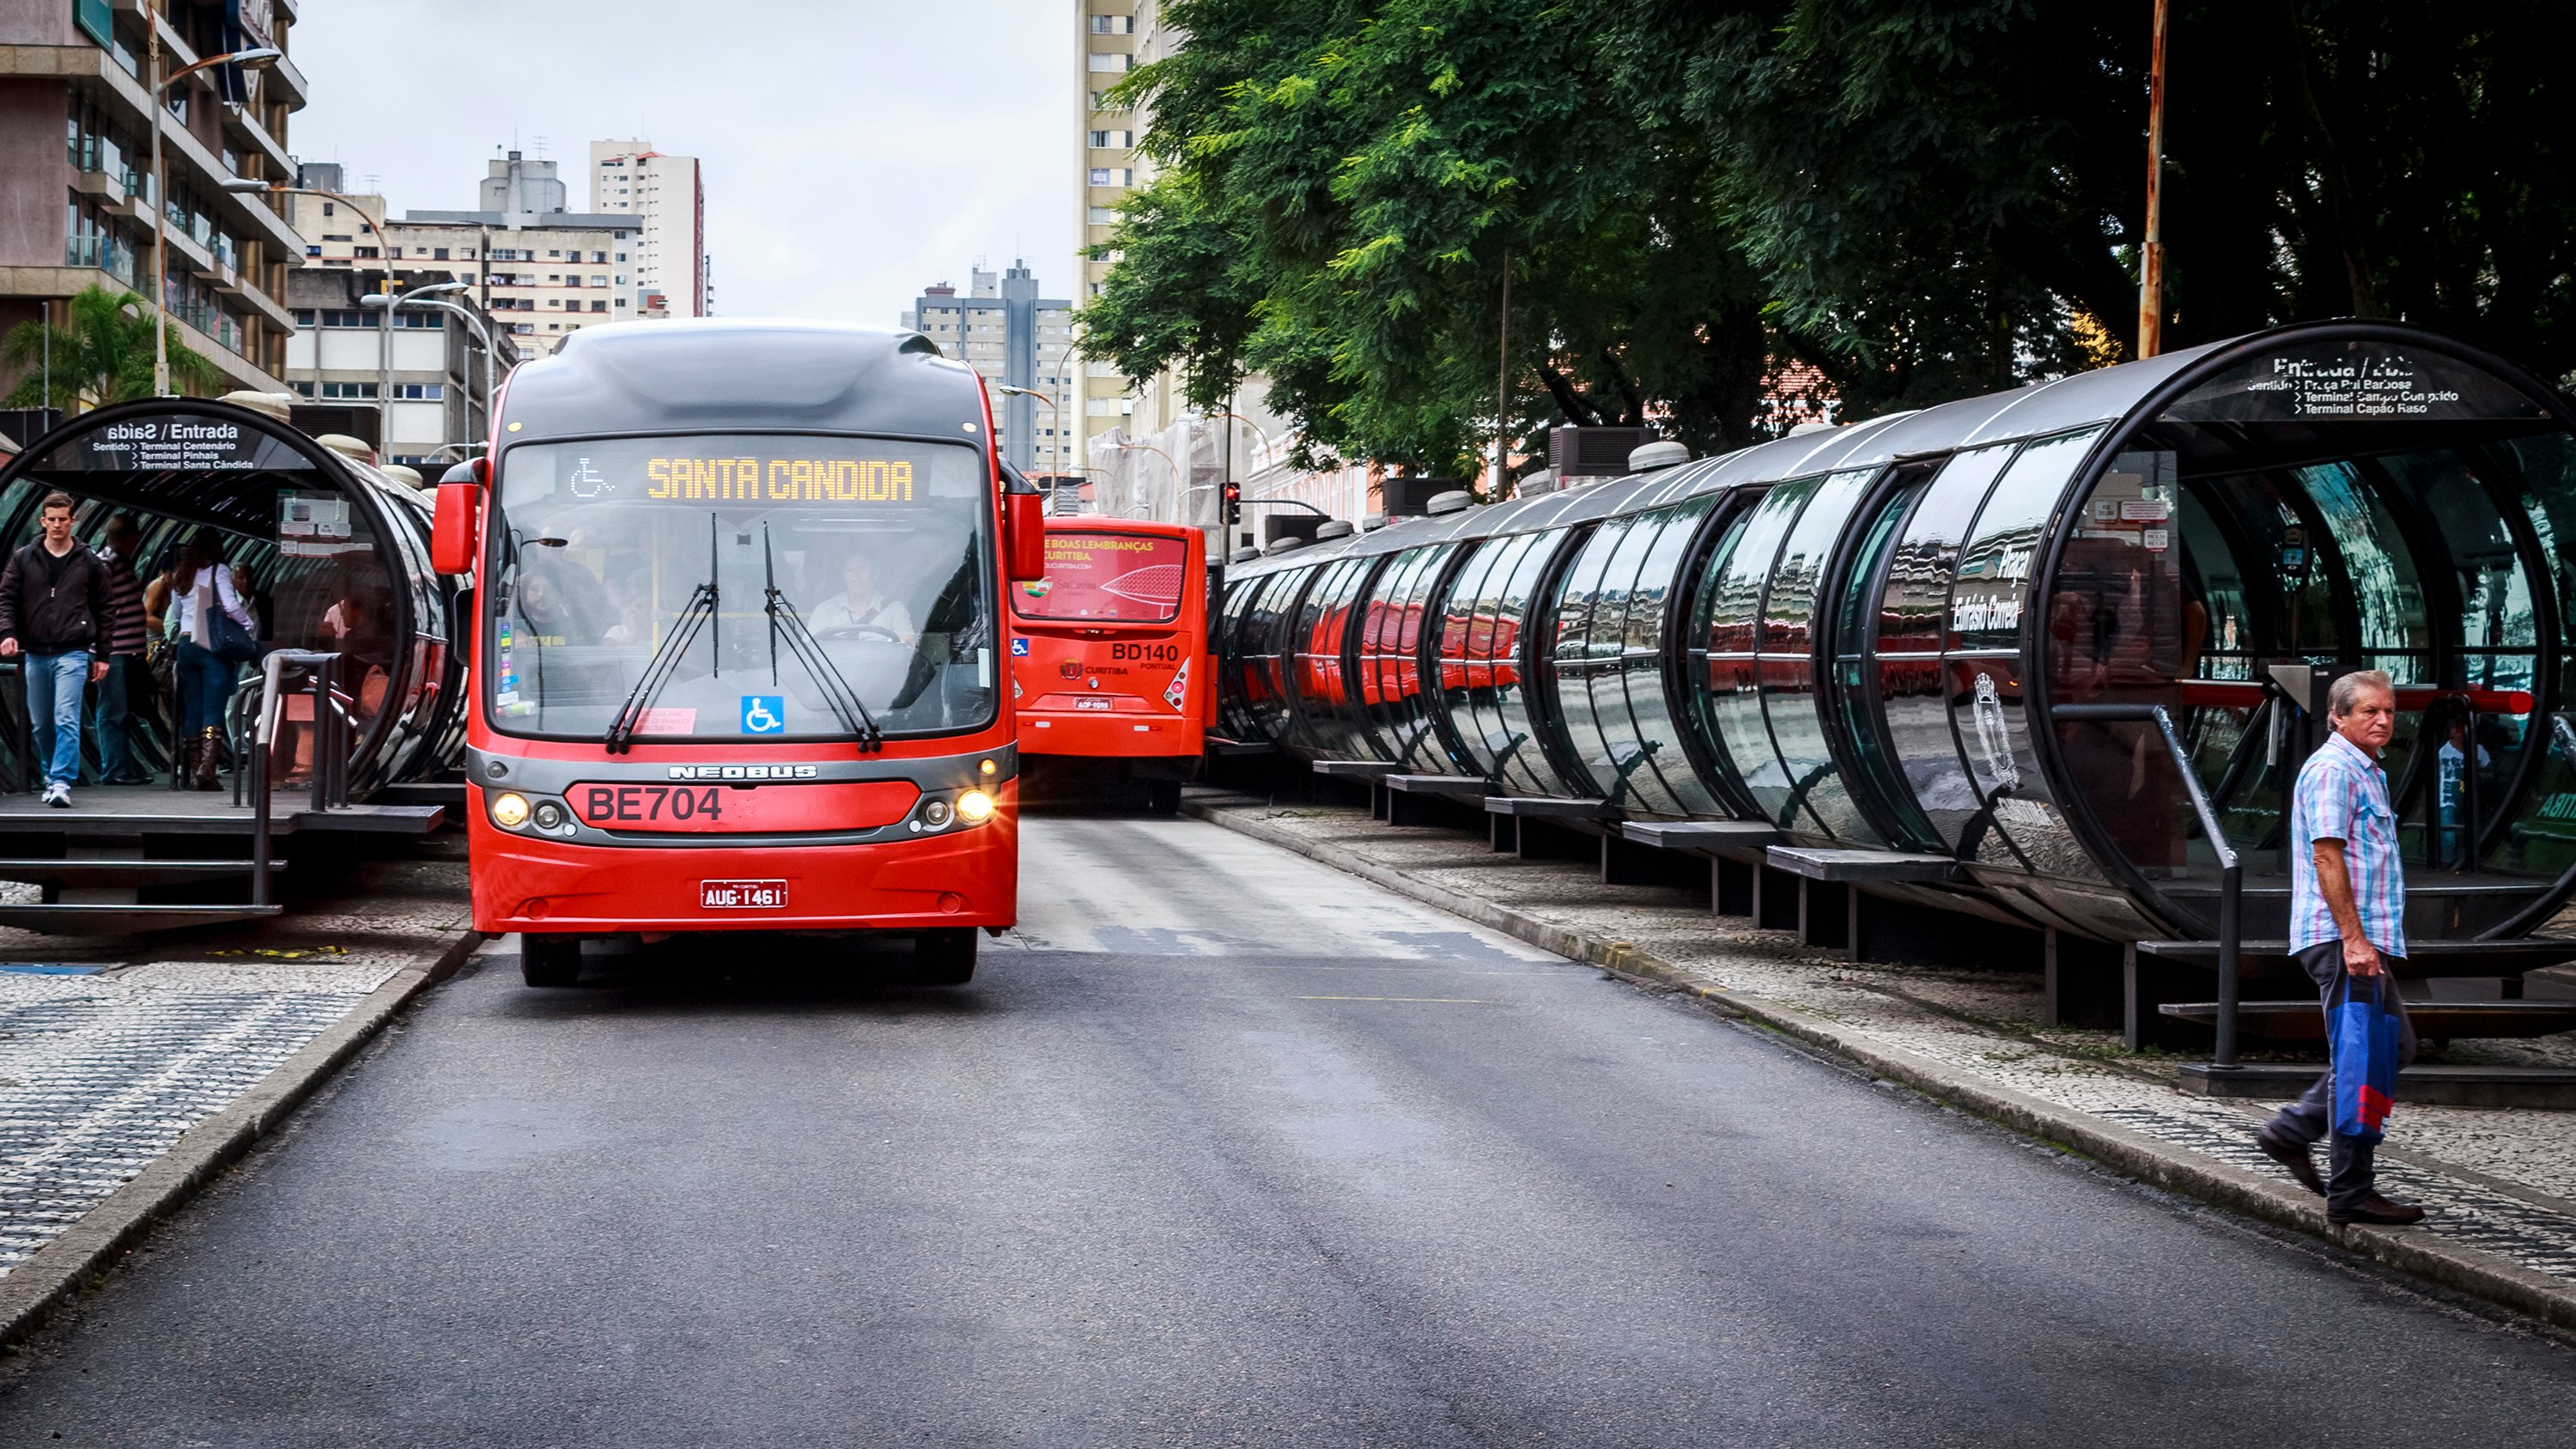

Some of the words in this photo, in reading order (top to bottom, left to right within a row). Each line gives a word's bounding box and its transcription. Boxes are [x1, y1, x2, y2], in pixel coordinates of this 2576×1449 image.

[2304, 404, 2354, 414] Terminal
[171, 423, 238, 440] Entrada
[93, 442, 131, 452] Sentido
[140, 441, 181, 451] Terminal
[183, 441, 236, 451] Centenário
[140, 452, 181, 460] Terminal
[183, 451, 220, 460] Pinhais
[140, 461, 181, 470] Terminal
[183, 460, 211, 470] Santa
[213, 460, 254, 470] Cândida
[648, 459, 759, 499] SANTA
[768, 460, 913, 501] CANDIDA
[1052, 539, 1081, 549] BOAS
[1082, 539, 1154, 553] LEMBRANÇAS
[1996, 544, 2031, 588] Praça
[1112, 642, 1178, 662] BD140
[1084, 667, 1128, 675] CURITIBA
[1140, 662, 1177, 671] PONTUAL
[668, 765, 817, 780] NEOBUS
[587, 787, 722, 821] BE704
